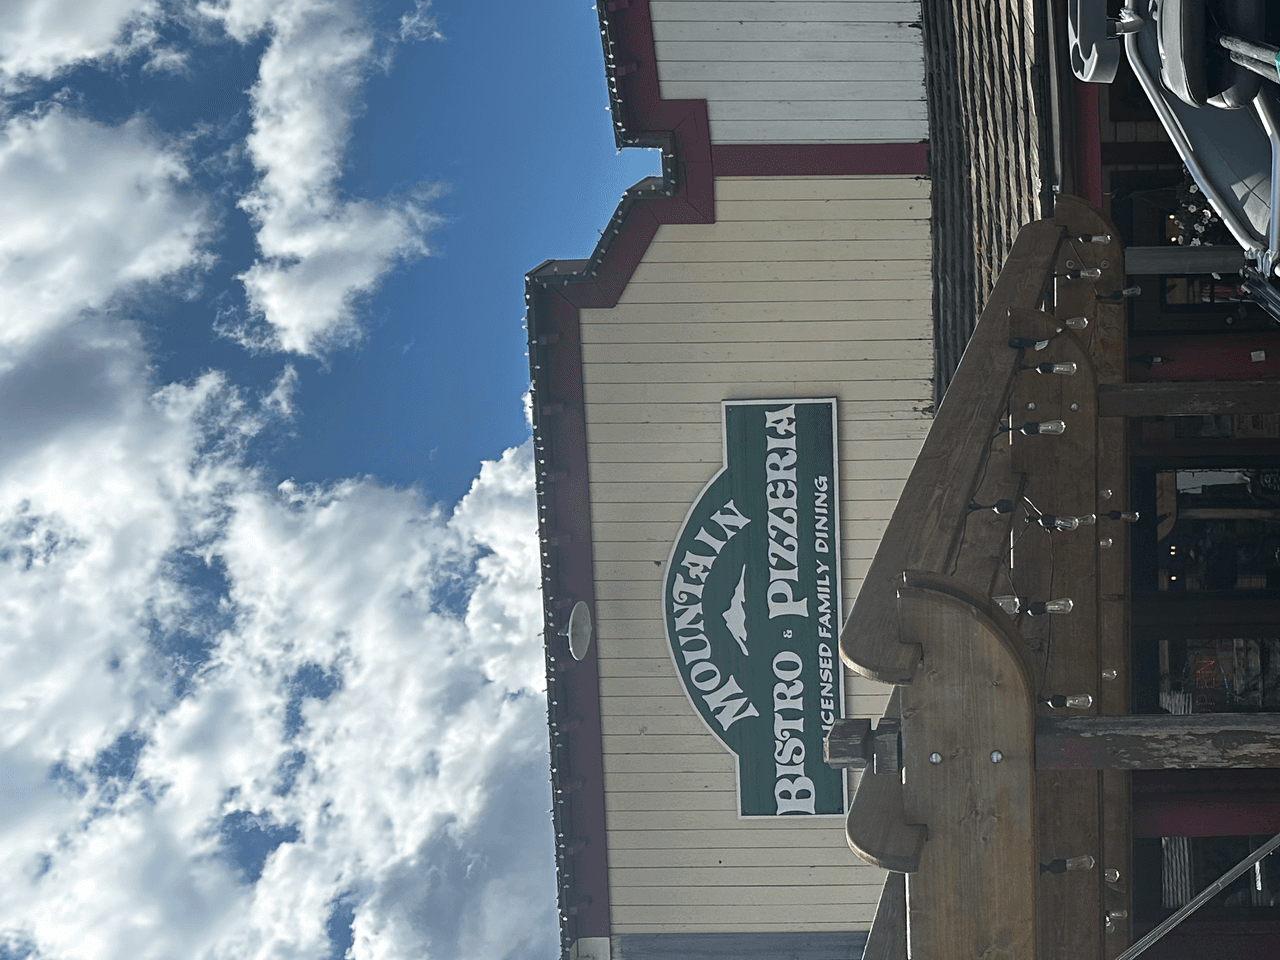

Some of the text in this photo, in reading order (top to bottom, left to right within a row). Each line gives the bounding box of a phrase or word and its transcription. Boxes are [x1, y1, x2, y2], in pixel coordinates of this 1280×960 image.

[672, 499, 760, 732] MOUNTAIN
[764, 404, 816, 816] BISTRO & PIZZERIA
[814, 475, 834, 741] ICENSED FAMILY DINING
[1196, 660, 1215, 712] PEN
